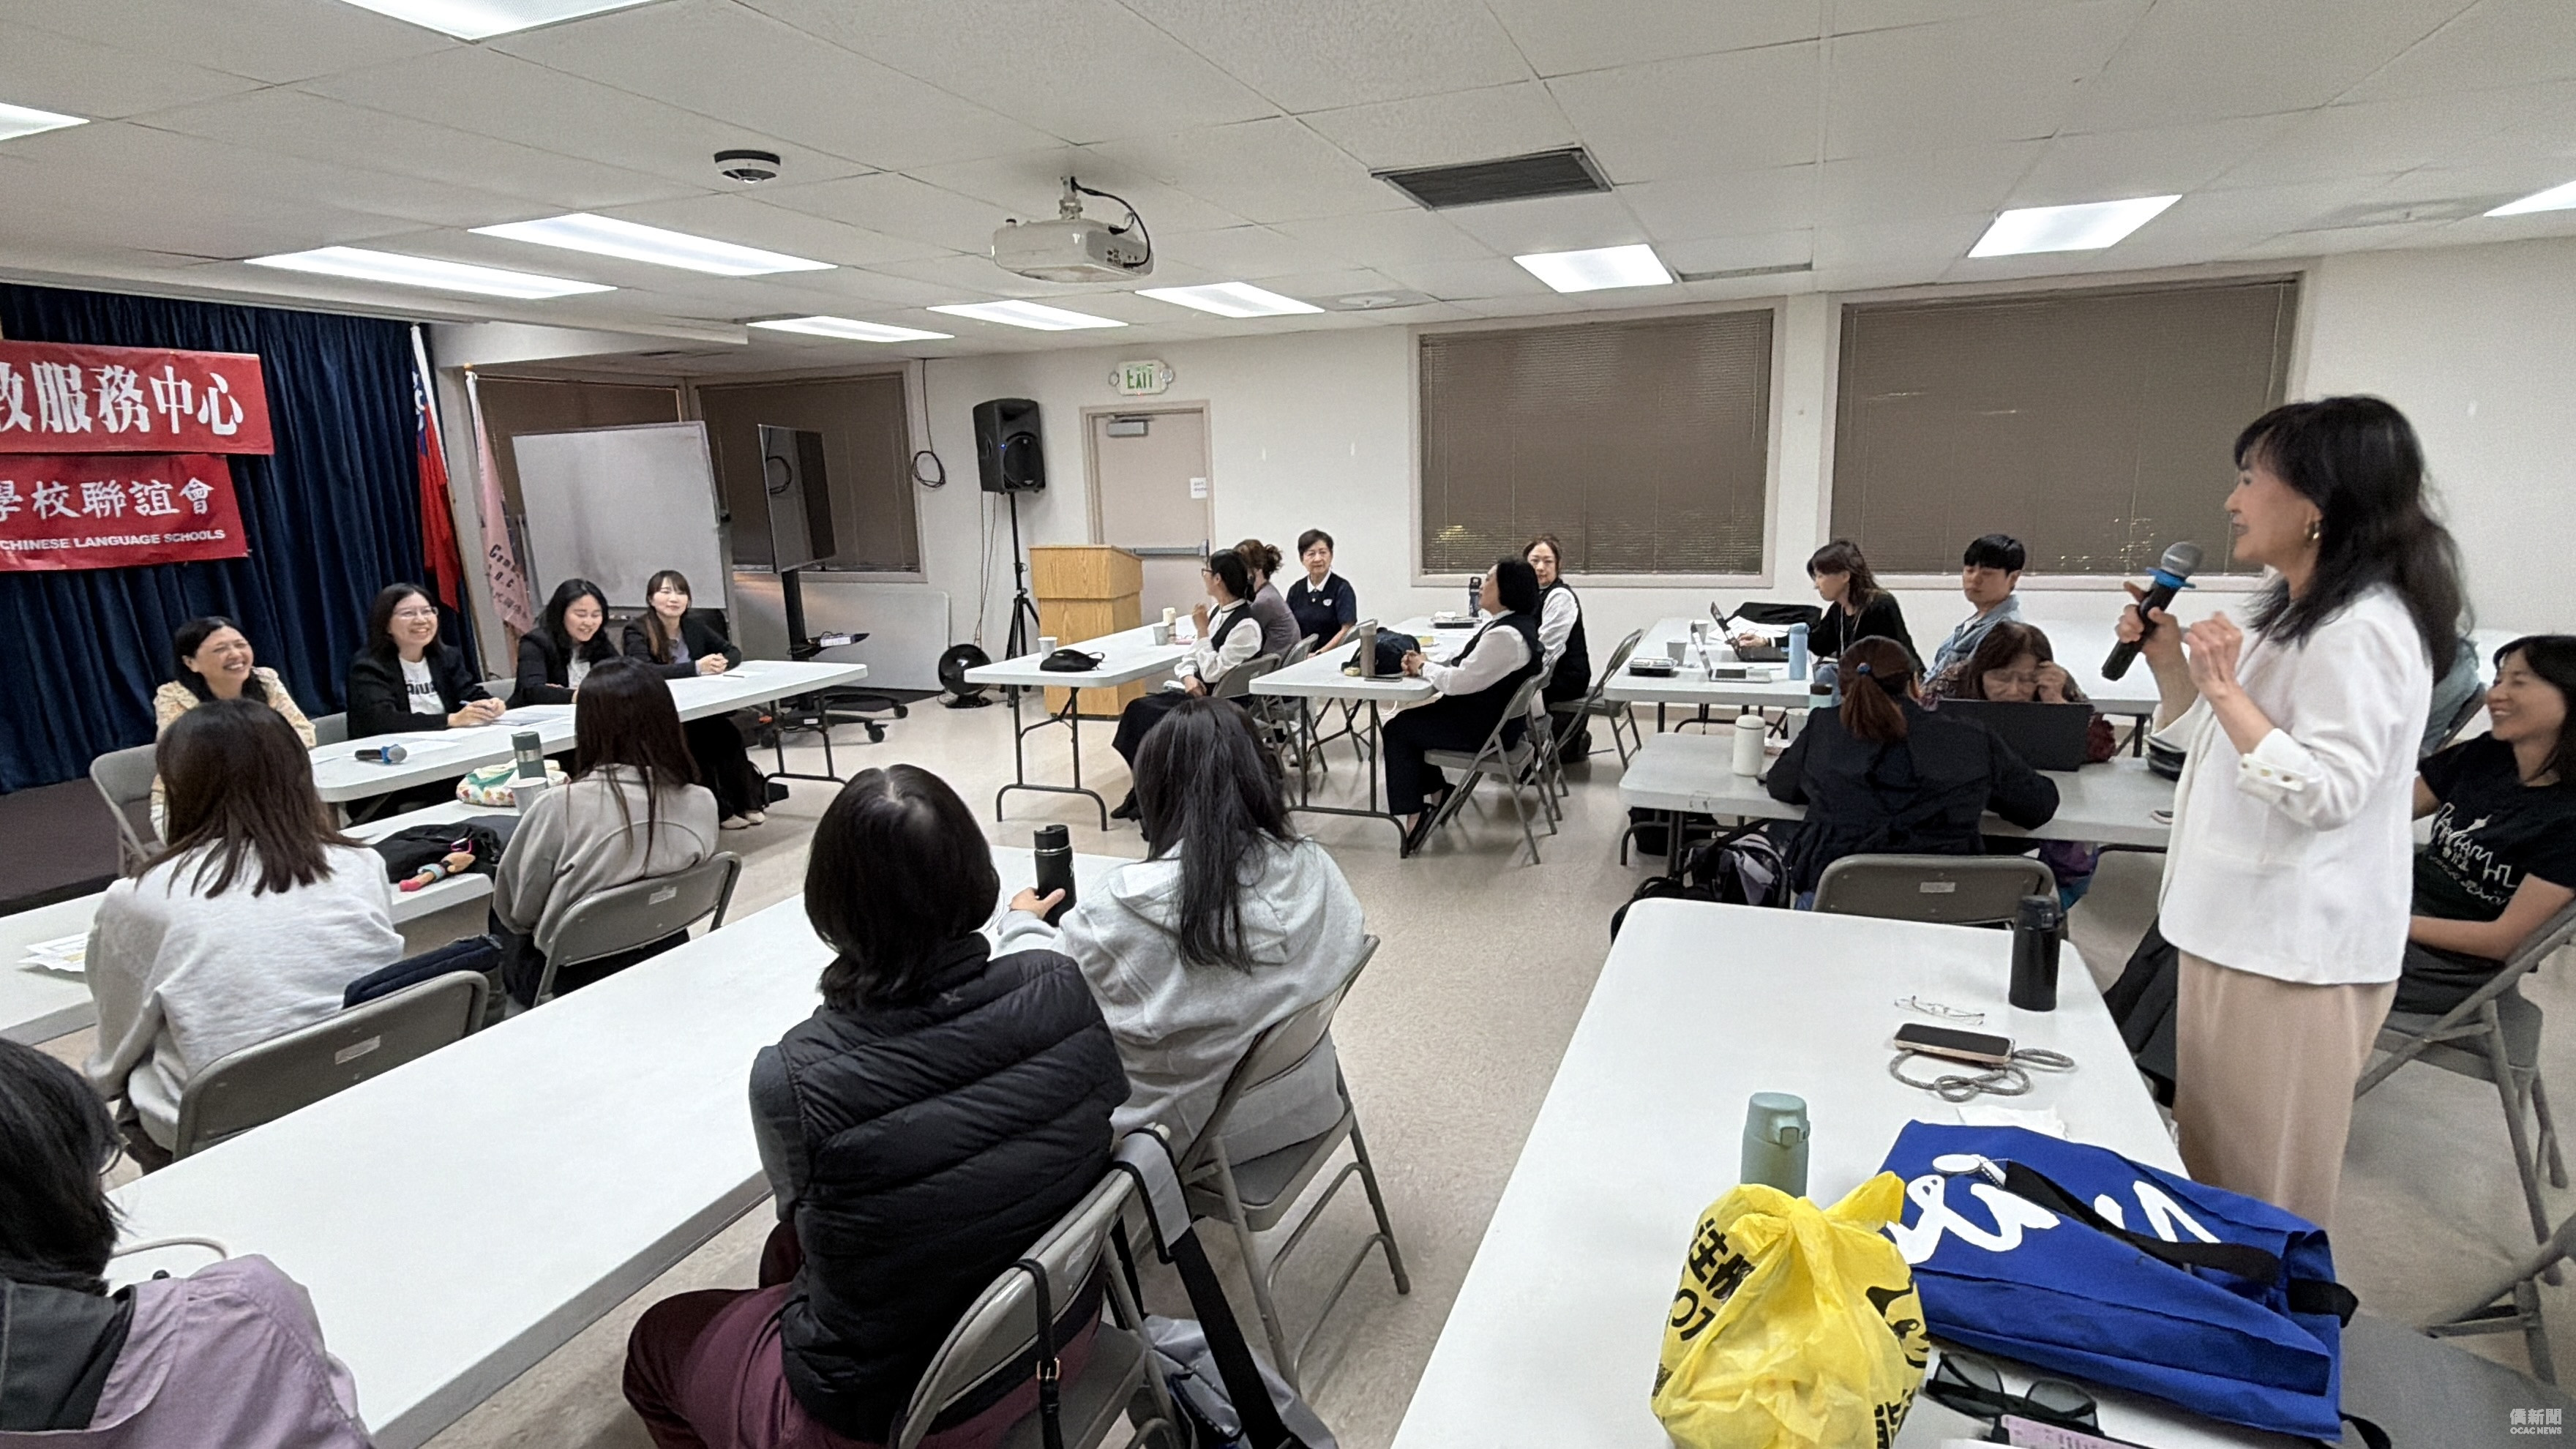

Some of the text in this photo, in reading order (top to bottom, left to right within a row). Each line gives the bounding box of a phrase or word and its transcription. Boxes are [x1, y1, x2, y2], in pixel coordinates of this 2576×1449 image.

[1126, 364, 1154, 389] EXIT
[0, 529, 225, 550] CHINESE LANGUAGE SCHOOLS
